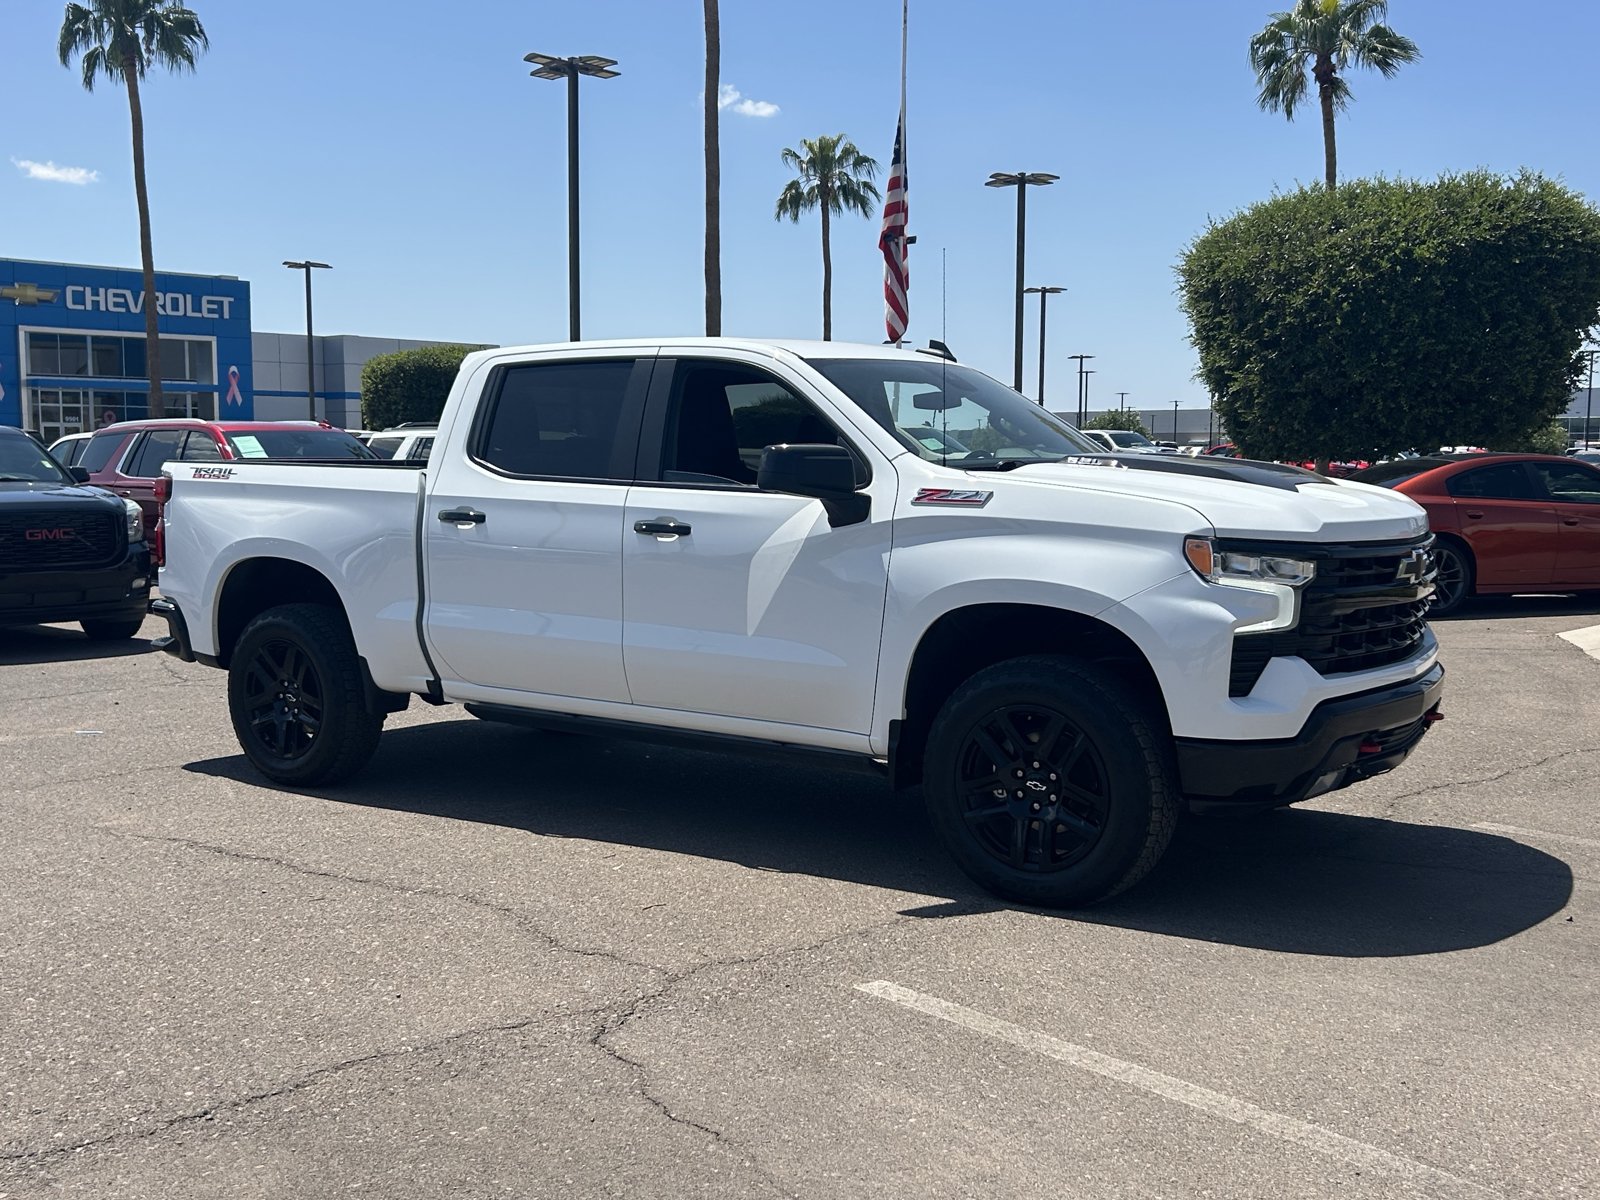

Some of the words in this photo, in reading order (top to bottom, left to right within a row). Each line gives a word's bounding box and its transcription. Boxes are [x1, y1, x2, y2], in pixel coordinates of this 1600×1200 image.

[65, 285, 234, 319] CHEVROLET
[189, 467, 238, 475] TRAIL
[912, 488, 993, 507] Z71
[25, 527, 76, 540] GMC
